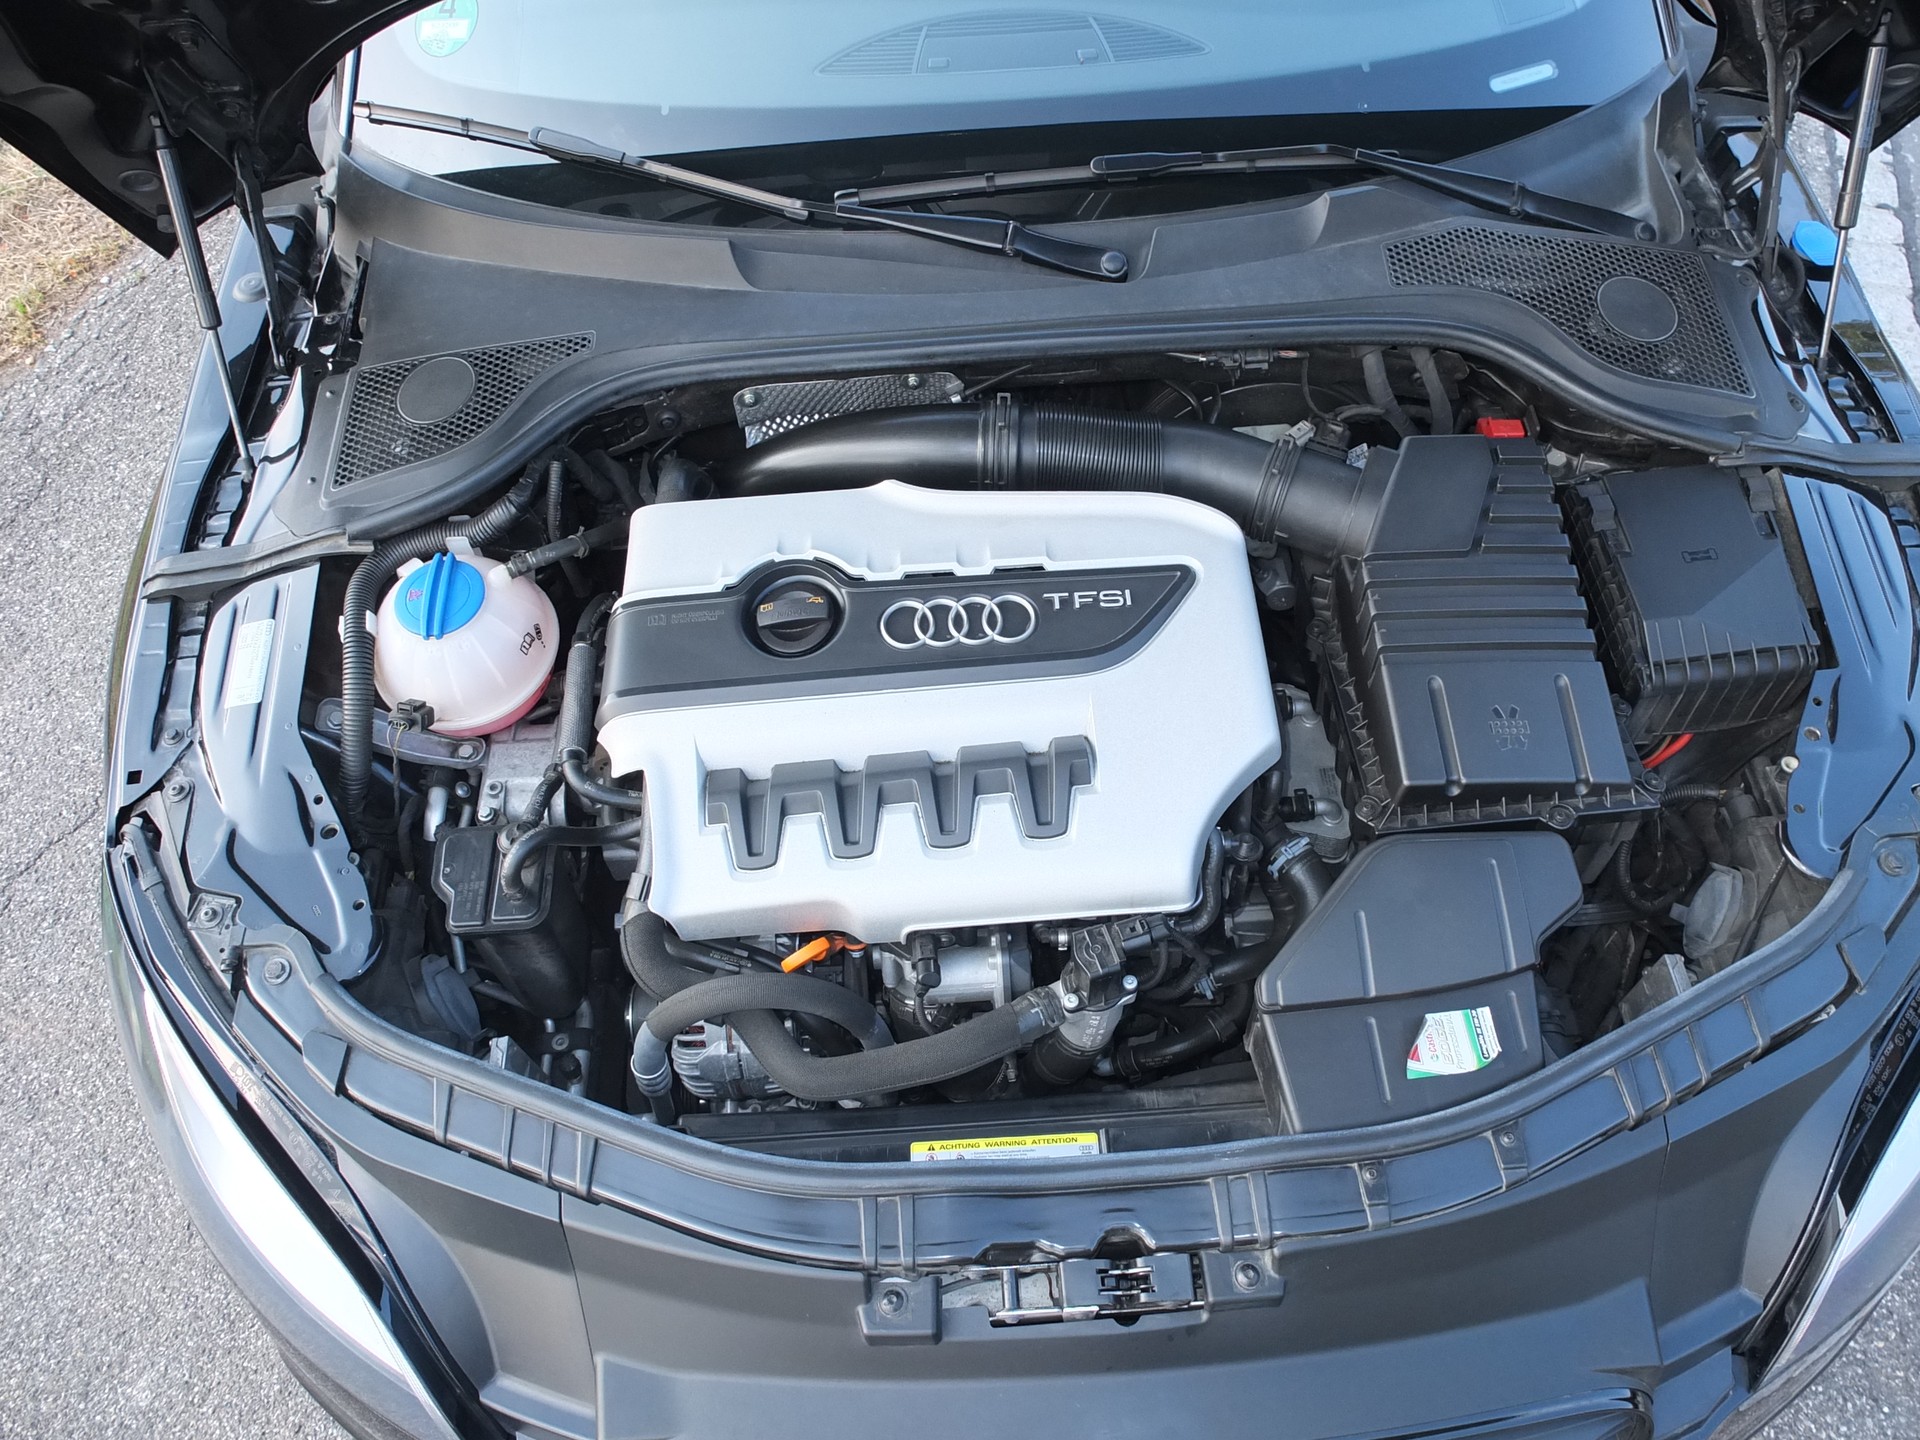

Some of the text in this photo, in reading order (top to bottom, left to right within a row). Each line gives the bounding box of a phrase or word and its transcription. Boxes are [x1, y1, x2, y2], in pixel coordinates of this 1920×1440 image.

[1043, 589, 1132, 610] TFSI
[939, 1136, 1078, 1151] ACHTUNG WARNING ATTENTION
